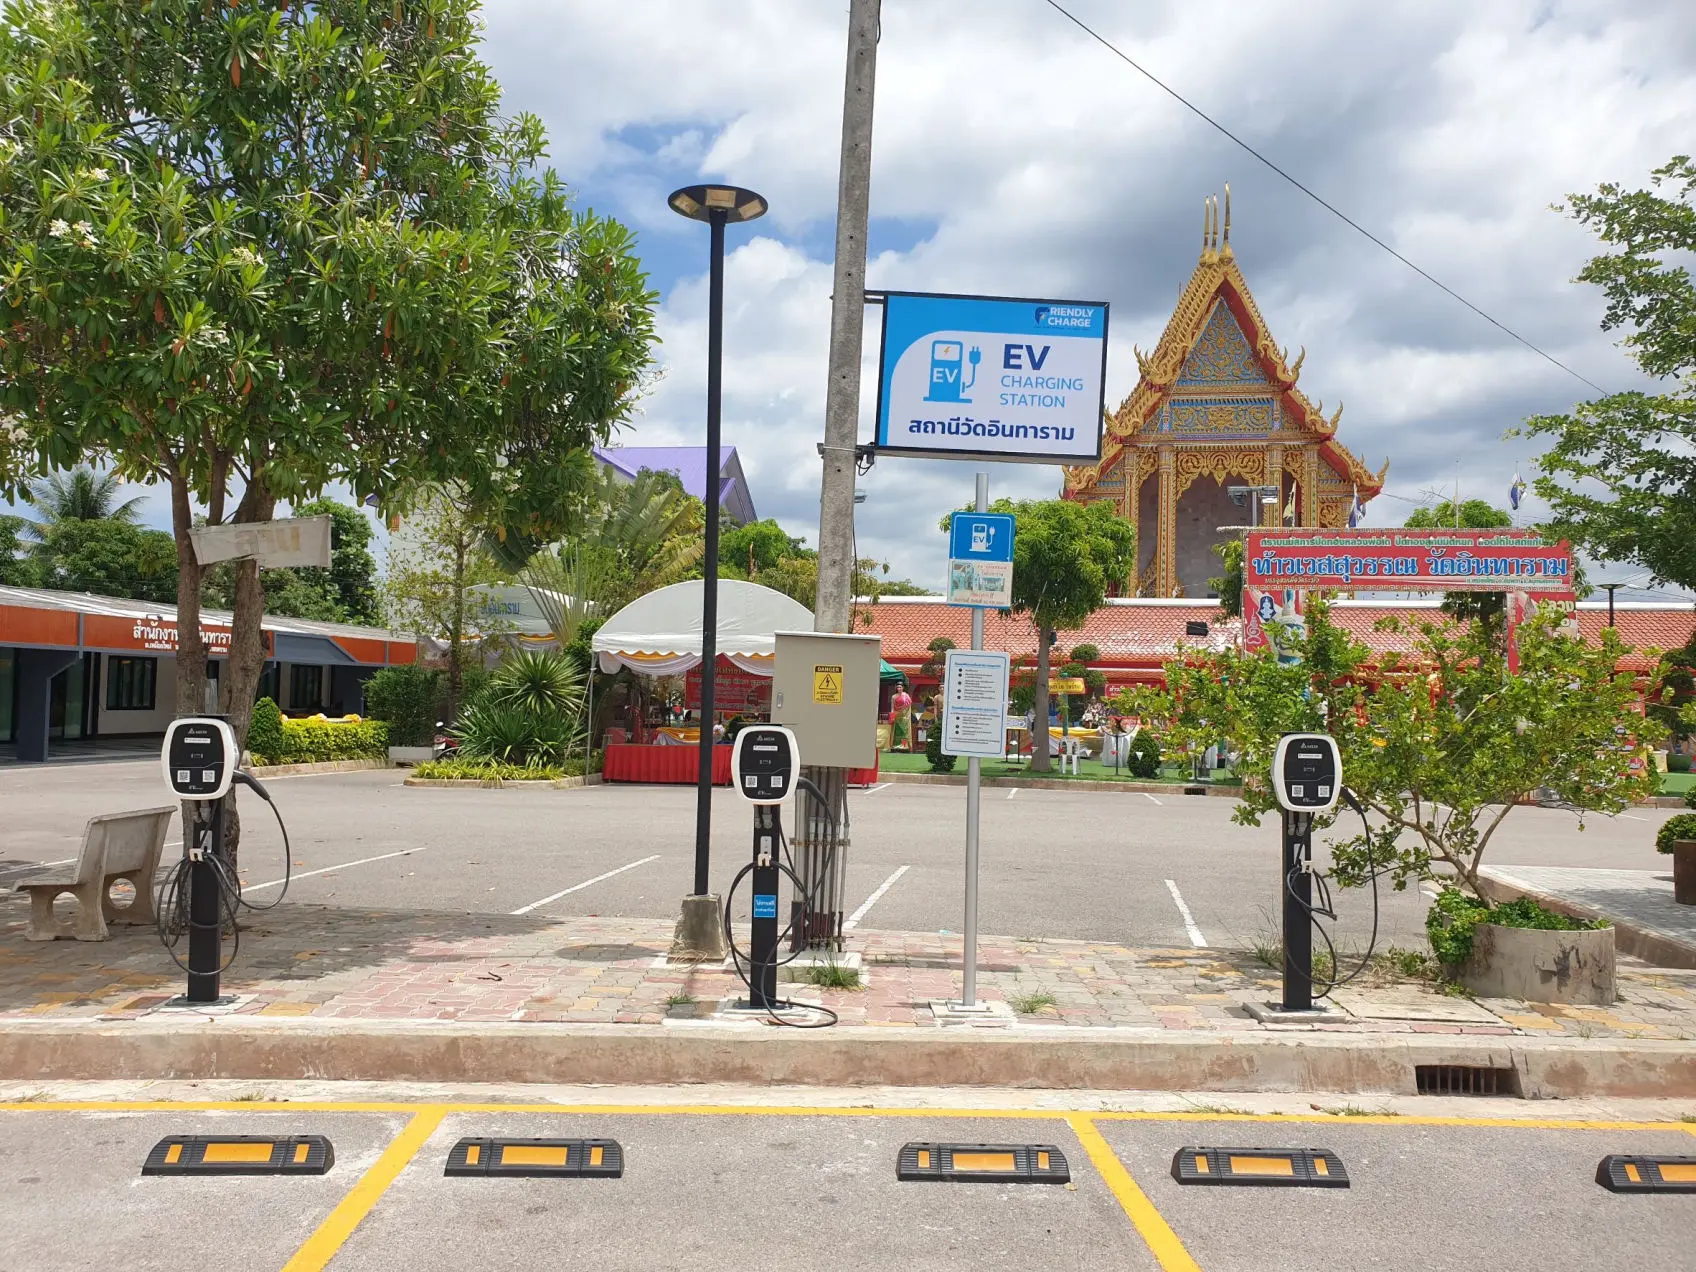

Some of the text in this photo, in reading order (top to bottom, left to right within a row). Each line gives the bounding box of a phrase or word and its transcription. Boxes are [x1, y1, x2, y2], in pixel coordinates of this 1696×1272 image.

[1048, 317, 1091, 328] CHARGE
[1003, 344, 1051, 371] EV
[932, 367, 959, 383] EV
[1000, 375, 1084, 391] CHARGING
[1000, 393, 1066, 408] STATION
[908, 417, 1075, 441] สถานีวัดอินทาราม
[1252, 548, 1568, 582] ท้าวเวสสุวรรณ วัดอินทาราม
